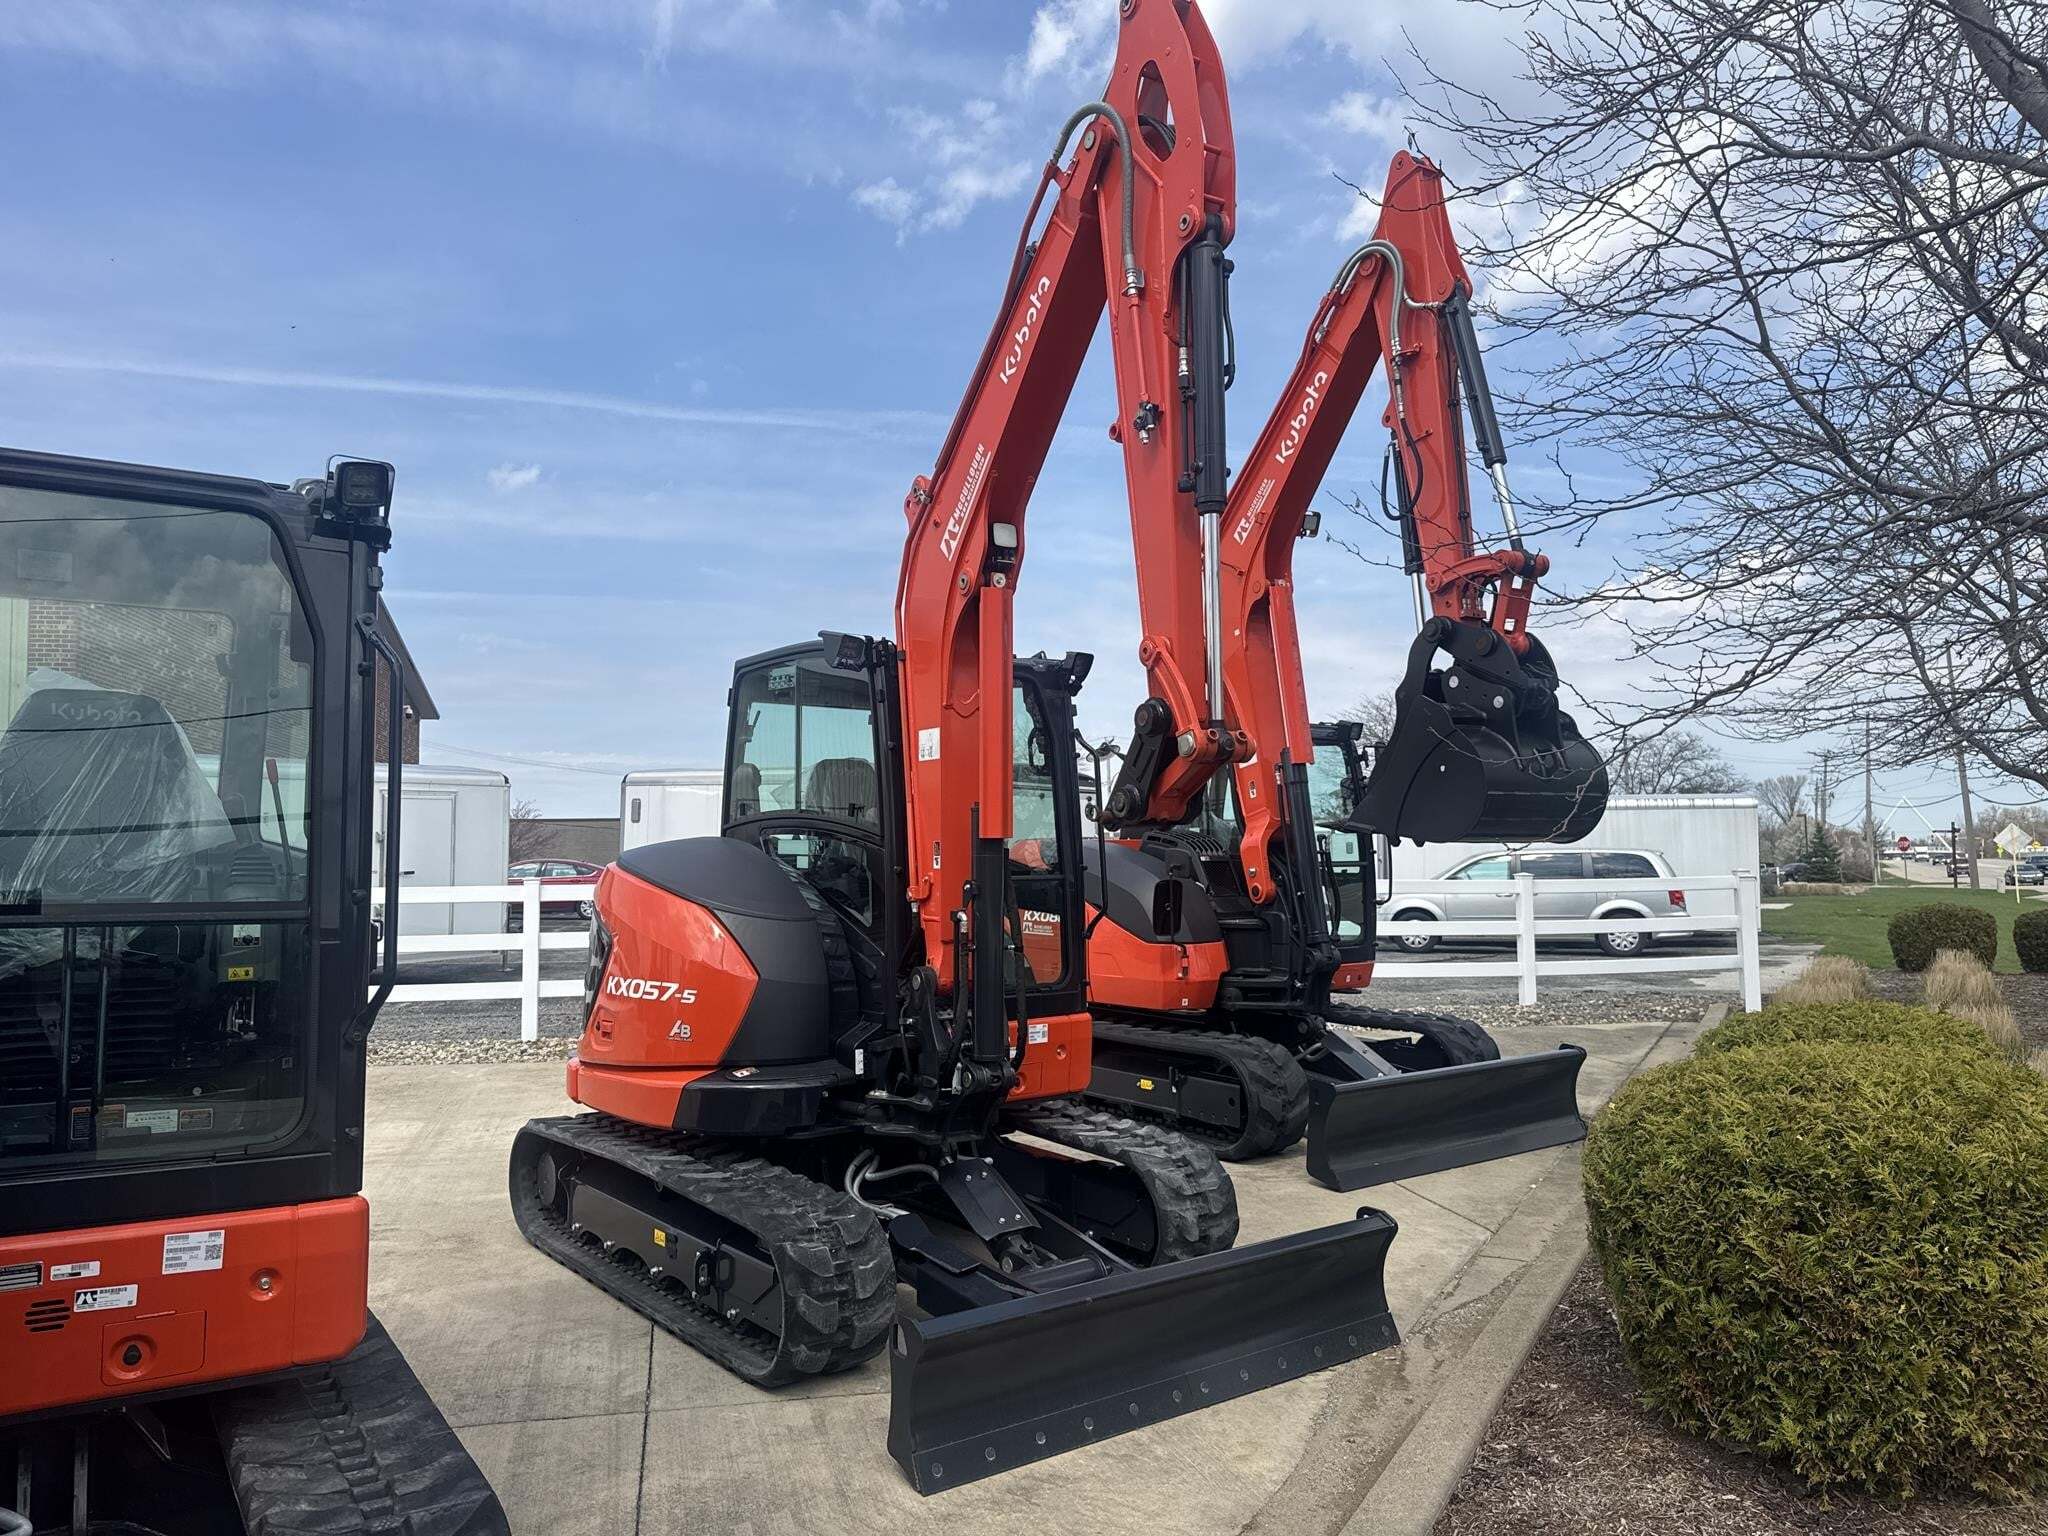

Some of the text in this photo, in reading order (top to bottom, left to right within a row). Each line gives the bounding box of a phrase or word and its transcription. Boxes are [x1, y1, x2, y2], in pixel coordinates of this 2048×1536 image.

[1000, 276, 1051, 385] Kubota
[1275, 371, 1328, 464] Kubota
[51, 701, 141, 721] Kubota
